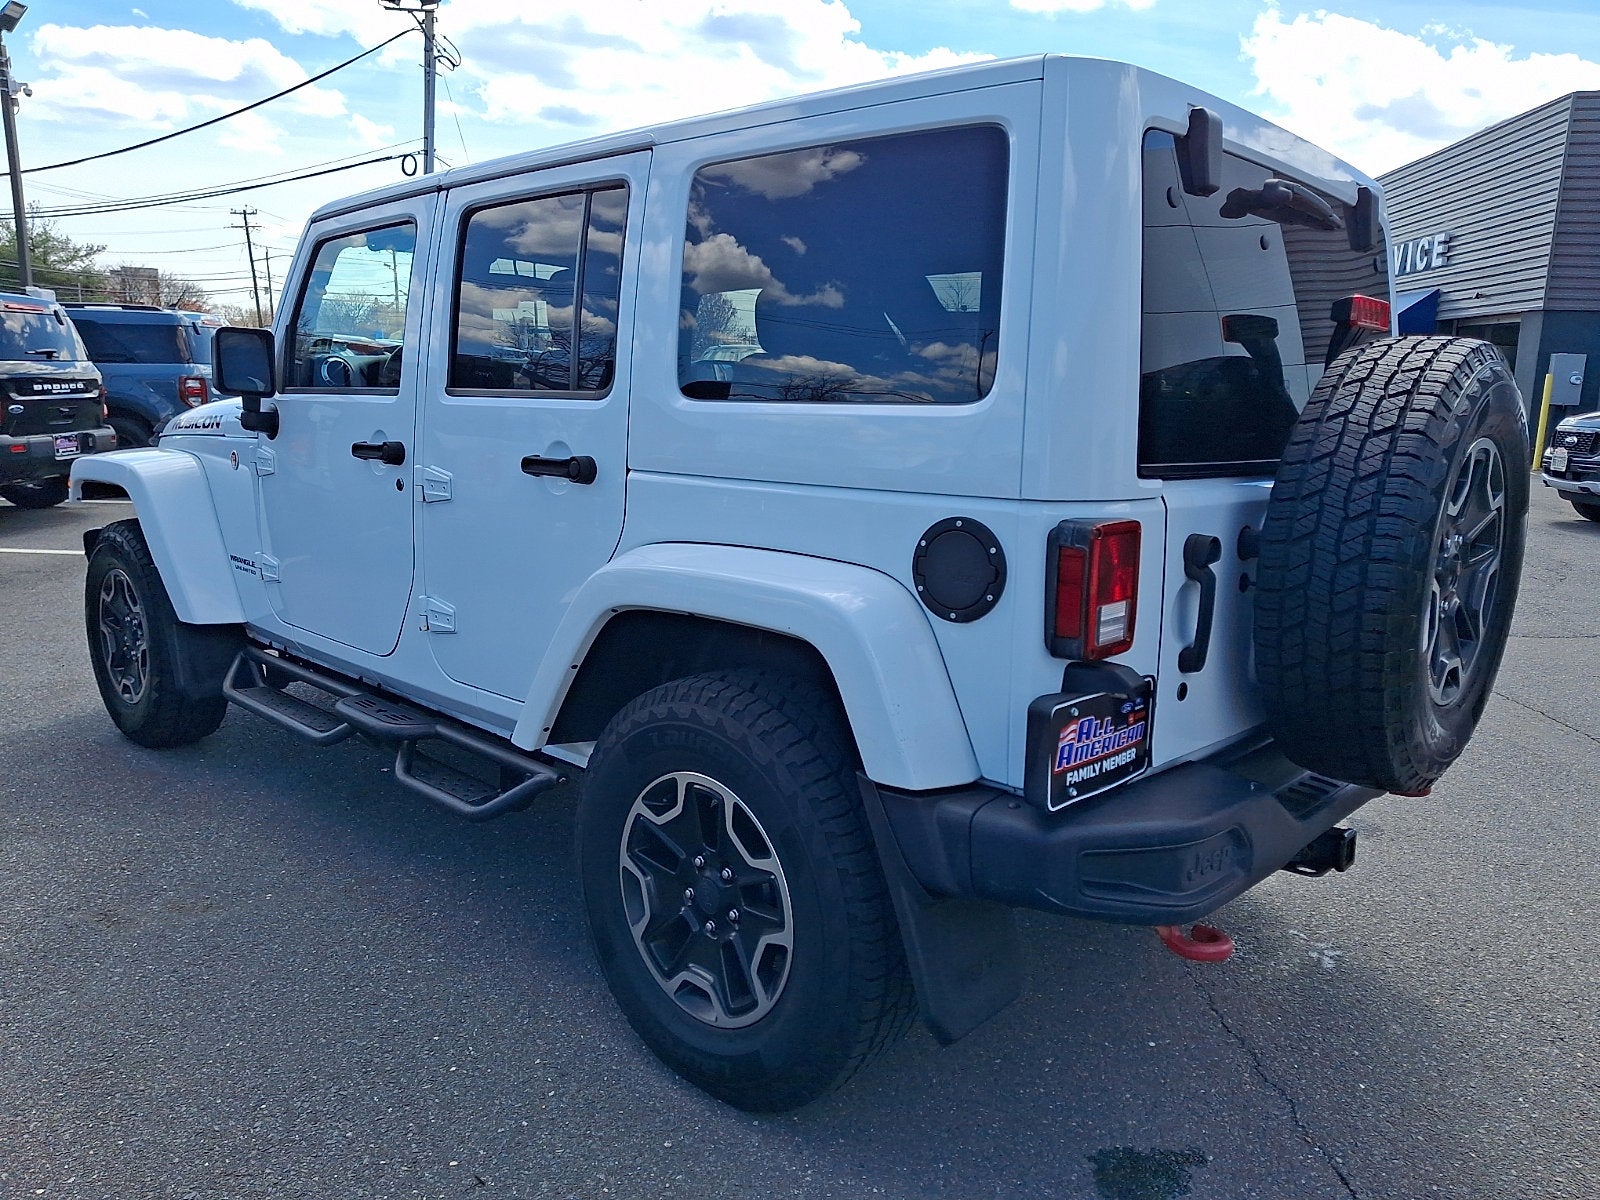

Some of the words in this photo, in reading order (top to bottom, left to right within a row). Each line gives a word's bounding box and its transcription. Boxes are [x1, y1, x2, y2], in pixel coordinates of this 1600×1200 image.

[33, 382, 84, 390] BRONCO
[172, 414, 224, 431] RUBICON
[1066, 762, 1101, 787] FAMILY
[1102, 747, 1137, 773] MEMBER
